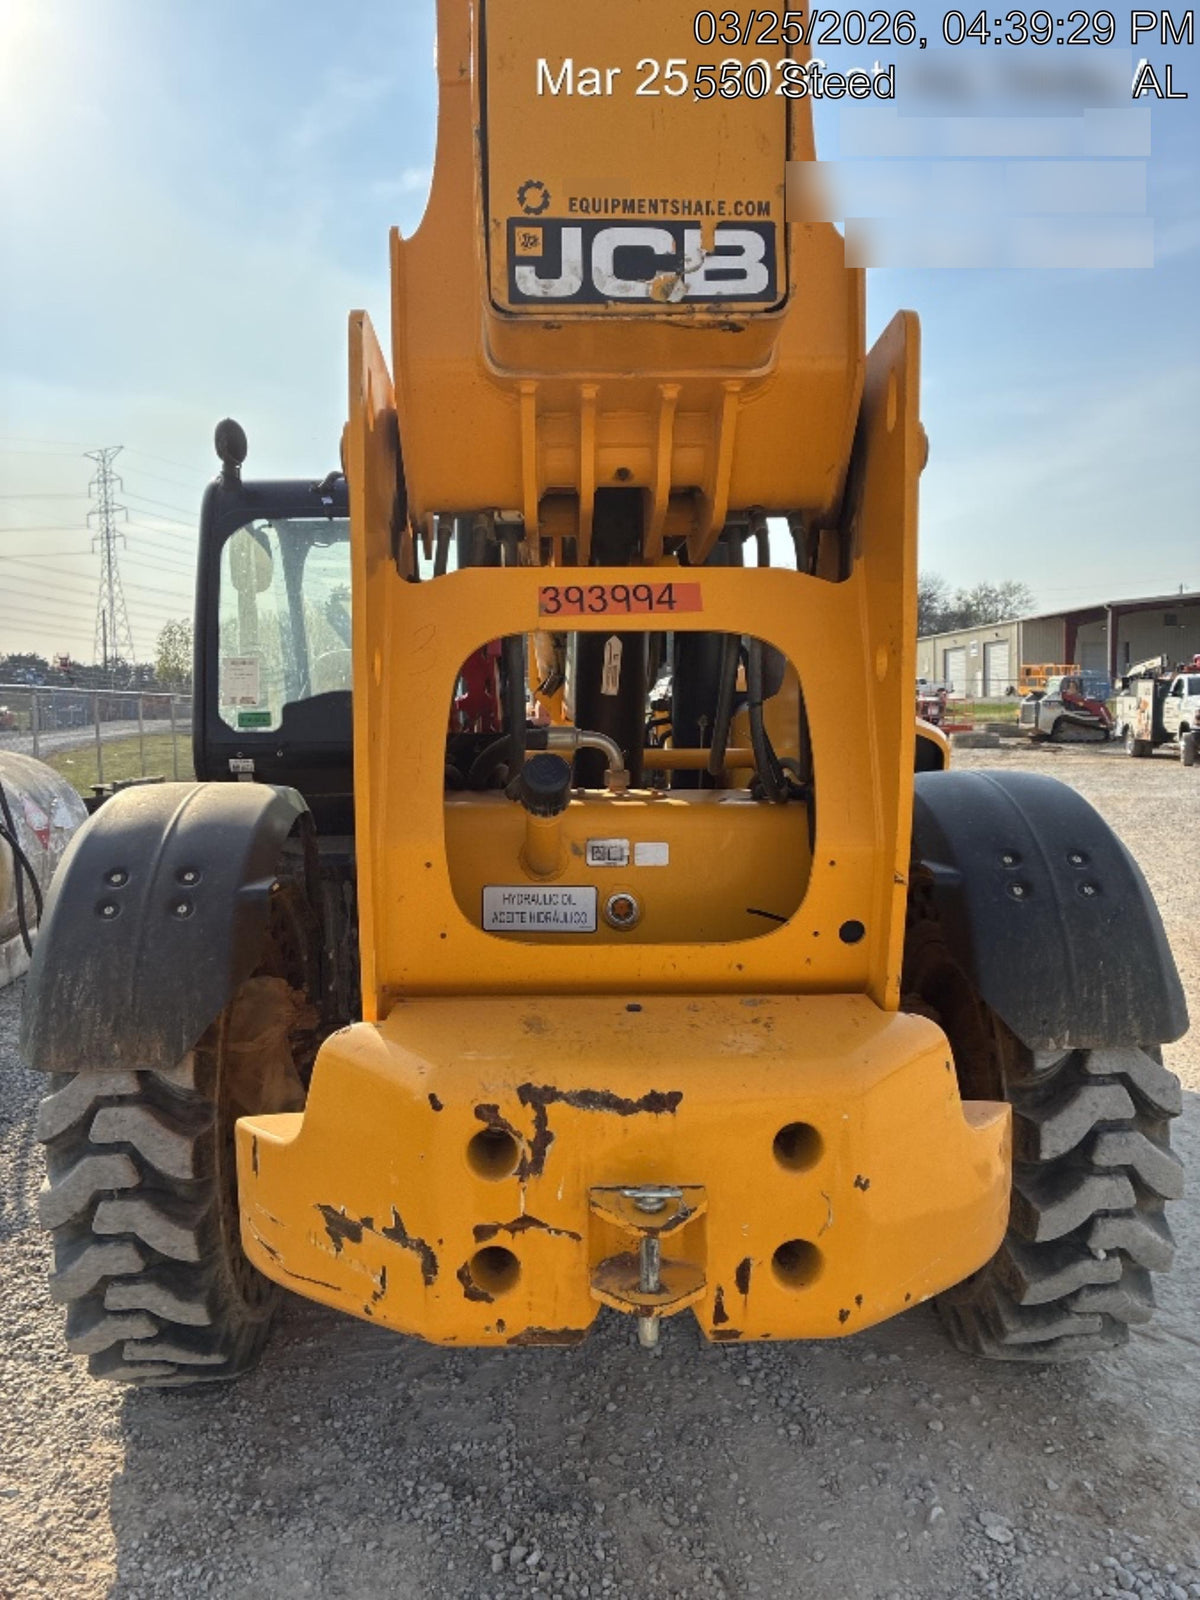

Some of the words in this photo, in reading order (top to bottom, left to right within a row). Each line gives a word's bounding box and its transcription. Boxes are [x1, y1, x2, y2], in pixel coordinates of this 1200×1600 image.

[514, 226, 769, 298] JCB
[541, 582, 677, 615] 393994
[491, 910, 527, 924] ACEITE
